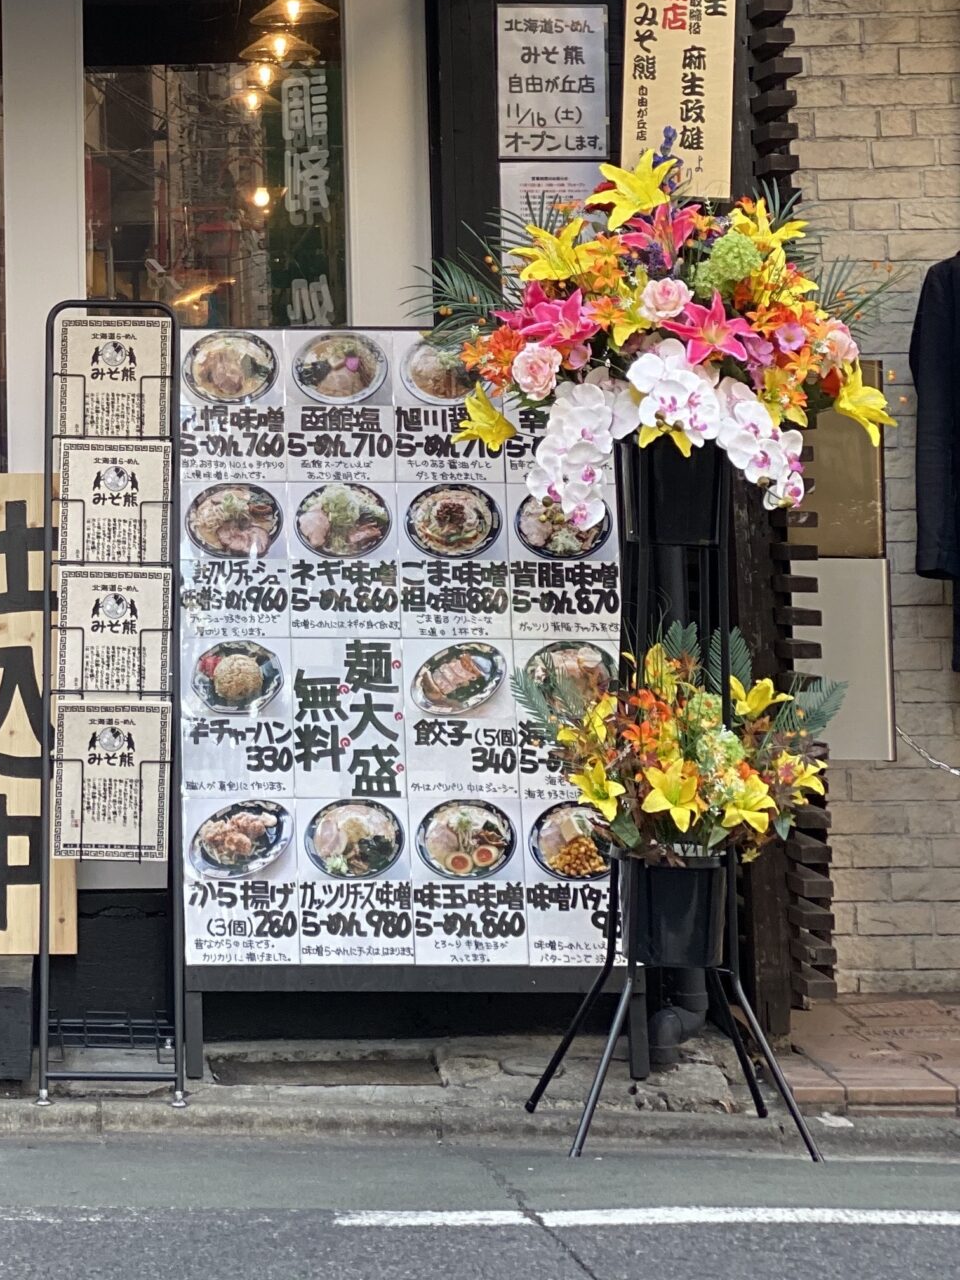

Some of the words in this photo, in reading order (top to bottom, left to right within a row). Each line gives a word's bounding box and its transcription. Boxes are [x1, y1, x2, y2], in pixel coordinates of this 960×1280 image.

[504, 18, 595, 34] 北海道らーめん
[632, 2, 659, 81] みそ熊
[521, 45, 586, 65] みそ熊
[508, 74, 595, 94] 自由が丘店
[91, 367, 137, 381] みそ熊
[93, 492, 138, 507] みそ熊
[291, 559, 398, 586] ネギ味噌
[402, 560, 508, 587] ごま味噌
[91, 620, 138, 634] みそ熊
[87, 752, 135, 767] みそ熊
[246, 745, 293, 772] 330
[471, 747, 516, 774] 340
[189, 881, 296, 910] から揚げ
